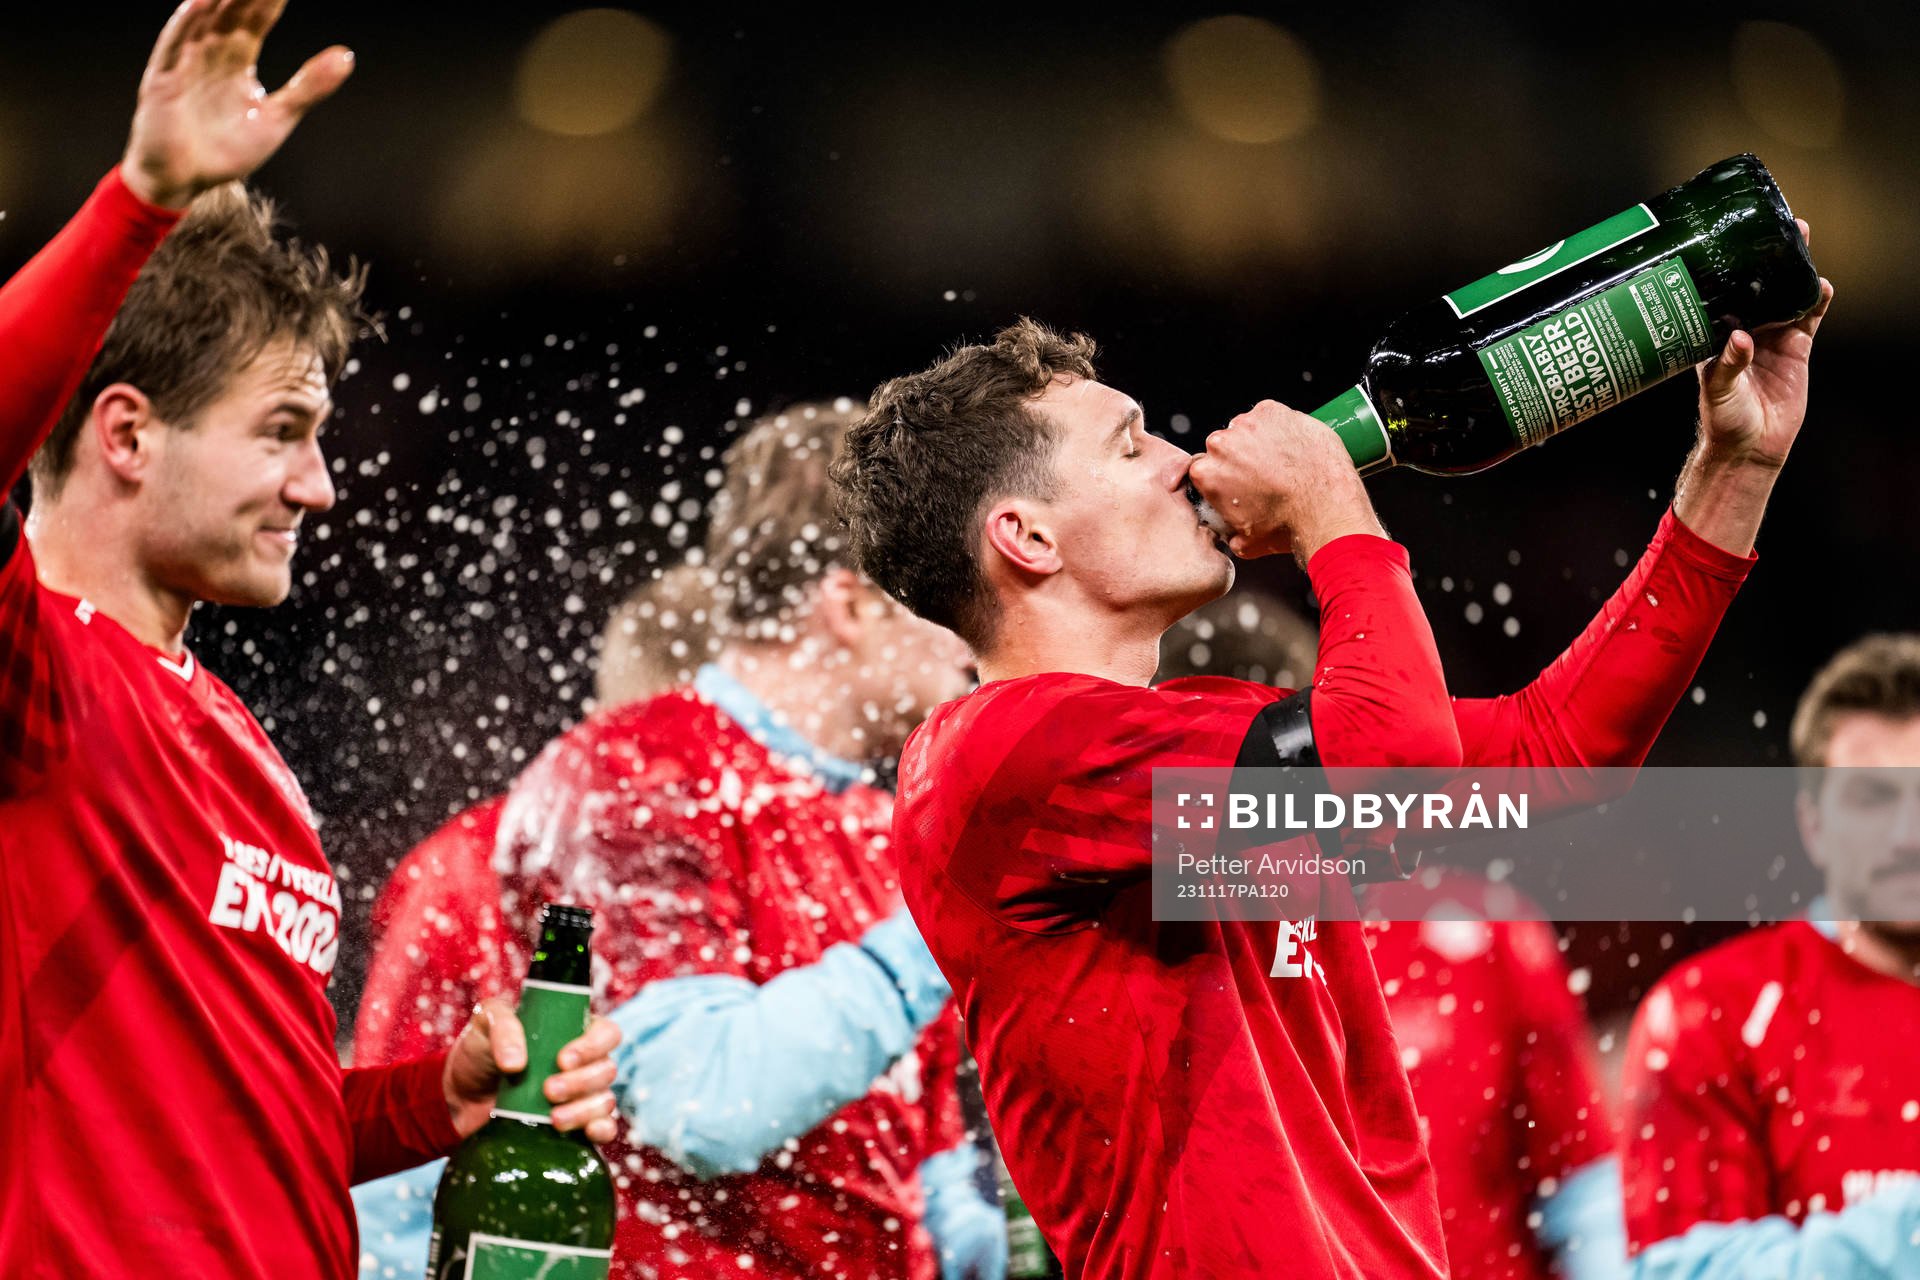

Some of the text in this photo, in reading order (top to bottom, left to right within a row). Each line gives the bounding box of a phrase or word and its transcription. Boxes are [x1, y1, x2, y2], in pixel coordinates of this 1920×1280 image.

[1639, 283, 1652, 302] GLASS
[1646, 281, 1668, 320] WIDELY RECYCLED
[1670, 288, 1689, 321] RESPONSIBLY
[1649, 305, 1663, 324] BOTTLE
[1678, 285, 1706, 343] drinkaware.co.uk
[1683, 319, 1694, 334] DRINK
[1540, 318, 1586, 385] BEER
[1561, 309, 1609, 385] WORLD
[1524, 329, 1573, 418] PROBABLY
[1494, 369, 1530, 447] NEERS OF PURITY
[1568, 380, 1596, 422] BEST
[1592, 380, 1614, 408] THE
